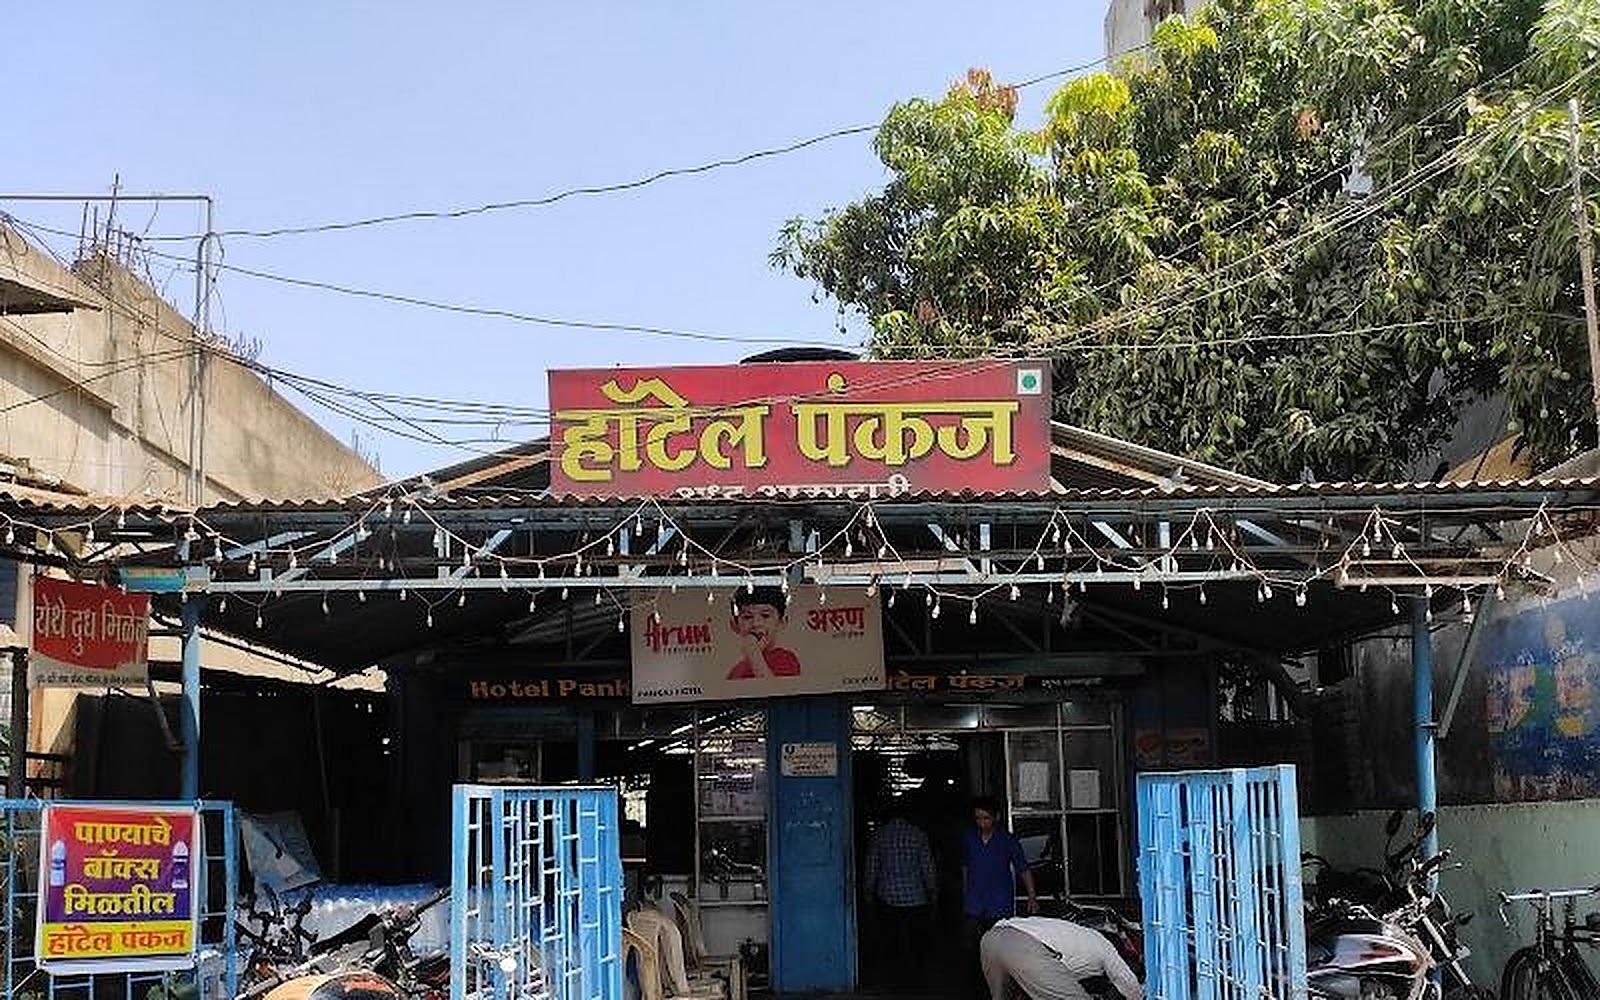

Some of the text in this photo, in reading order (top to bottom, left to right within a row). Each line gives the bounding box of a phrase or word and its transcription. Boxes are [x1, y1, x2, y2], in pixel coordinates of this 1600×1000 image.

[556, 373, 1020, 482] हॉटेल पंकज
[36, 593, 65, 639] येथे
[642, 612, 712, 653] Arun
[470, 679, 549, 698] Hotel
[73, 815, 173, 847] पाण्याचे
[83, 848, 160, 880] बॉक्स
[63, 883, 176, 915] मिळतील
[48, 923, 186, 956] हॉटेल पंकज
